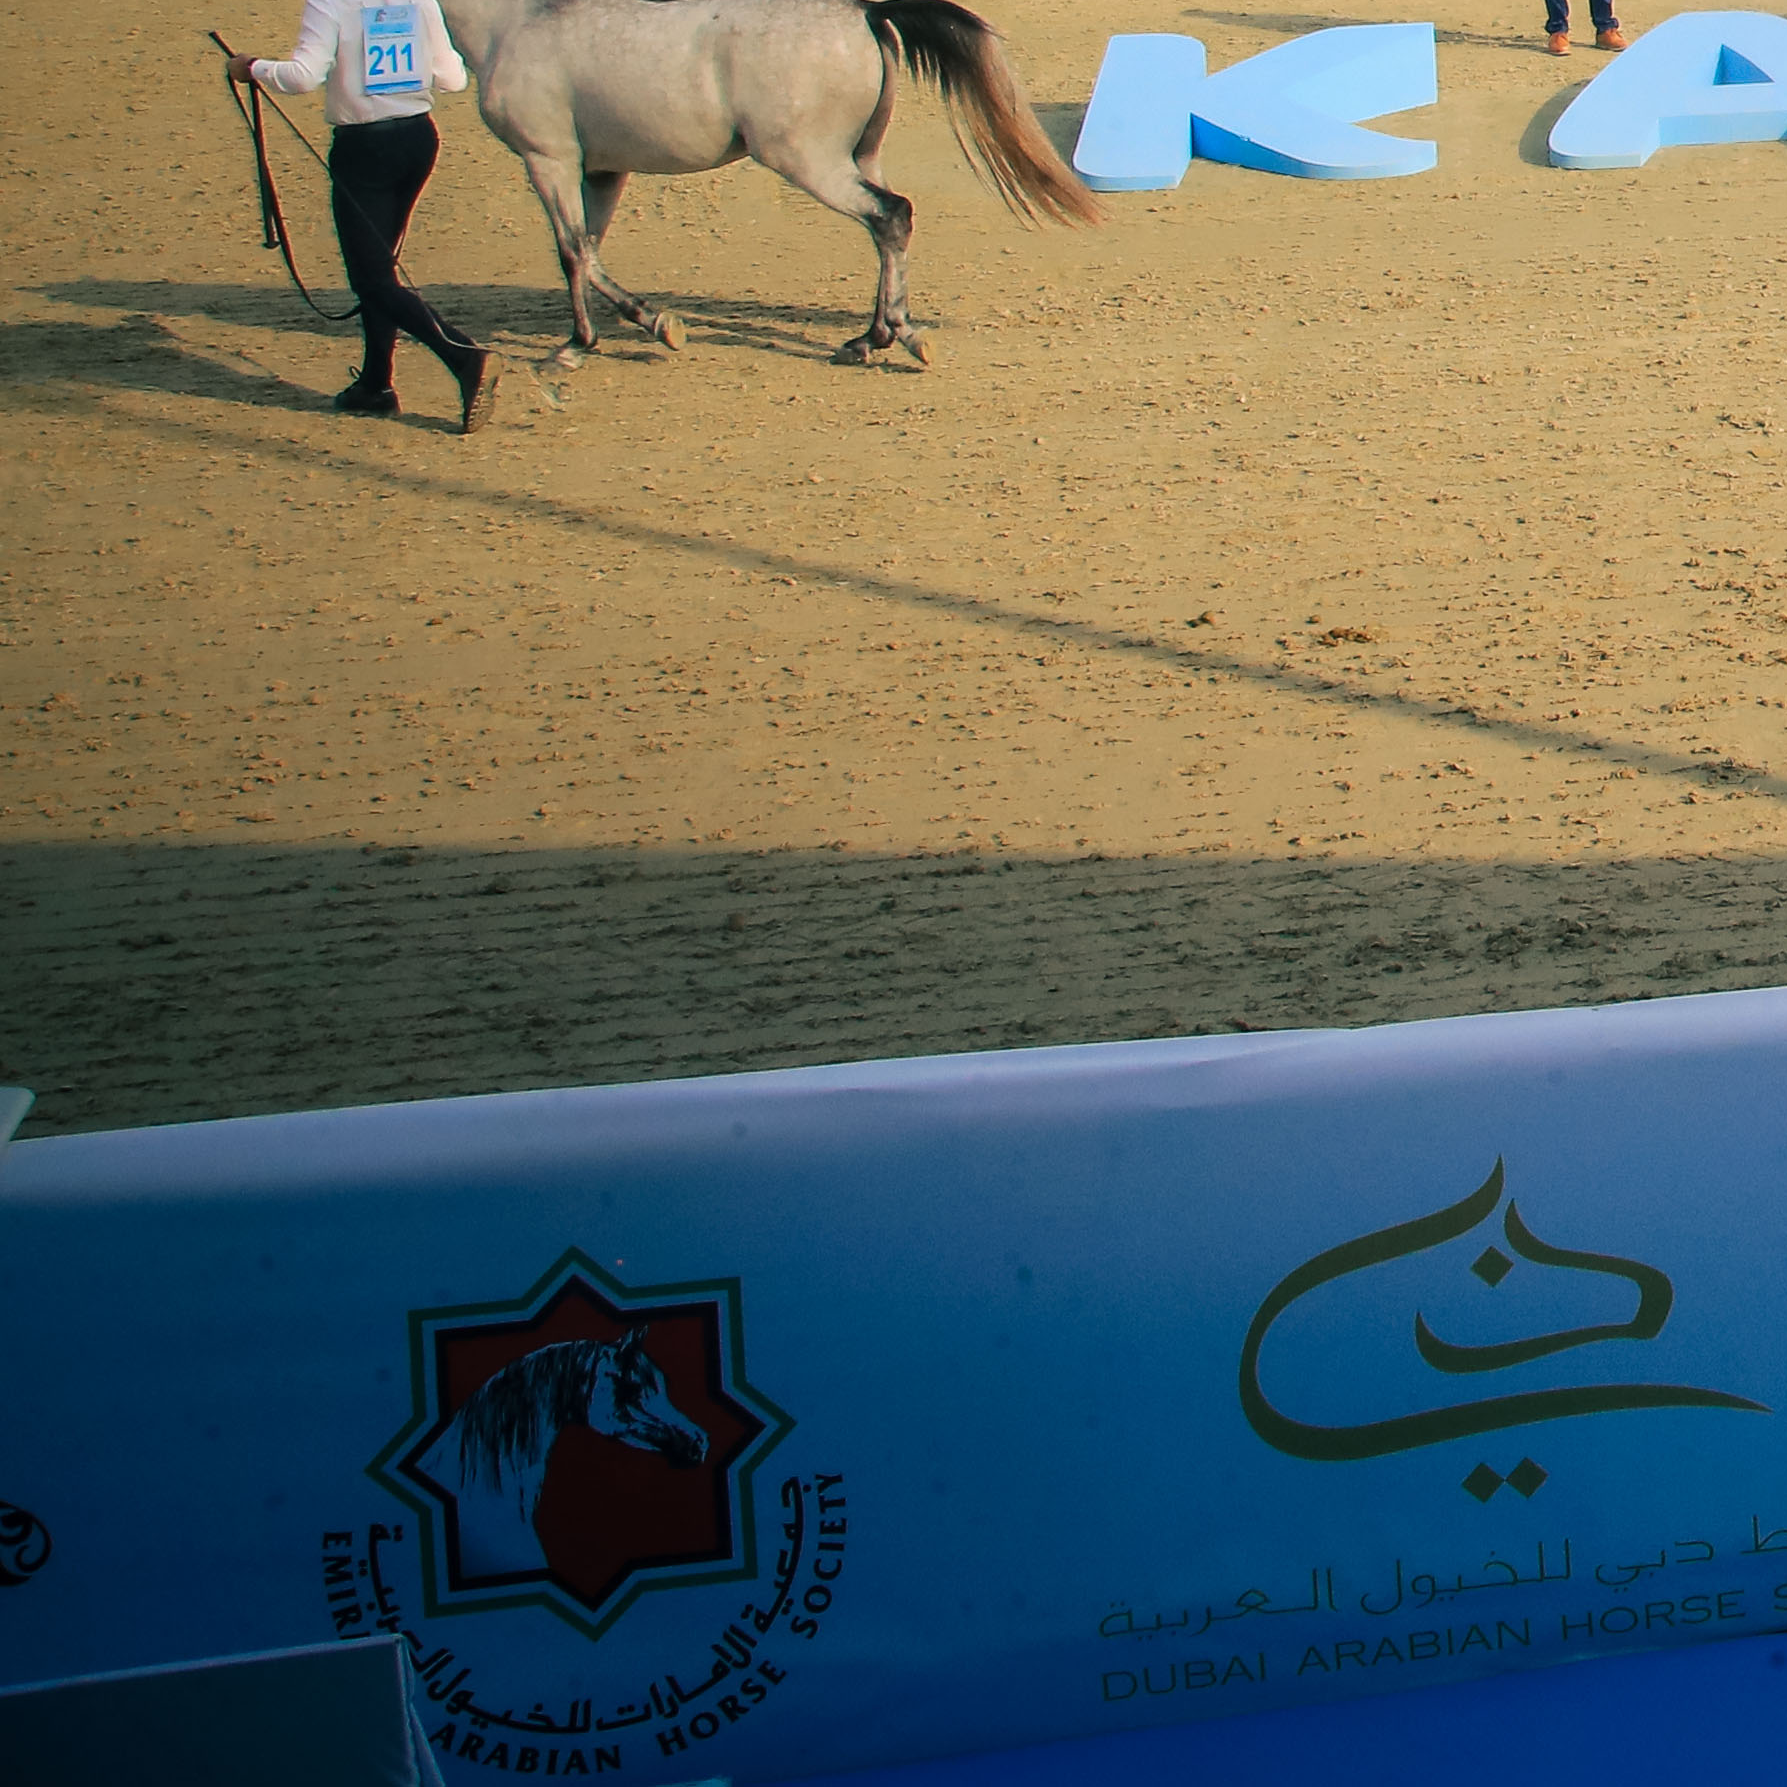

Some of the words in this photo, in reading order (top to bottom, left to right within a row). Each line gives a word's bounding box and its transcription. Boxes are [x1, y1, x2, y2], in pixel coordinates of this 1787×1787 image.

[368, 43, 414, 76] 211
[1096, 1566, 1341, 1640] العربية
[1359, 1537, 1572, 1615] للخيول
[1593, 1538, 1715, 1594] دبي
[428, 1721, 623, 1776] ARABIAN
[655, 1659, 788, 1755] HORSE
[790, 1472, 848, 1640] SOCIETY
[1101, 1651, 1267, 1703] DUBAI
[1296, 1618, 1532, 1677] ARABIAN
[1560, 1590, 1747, 1642] HORSE
